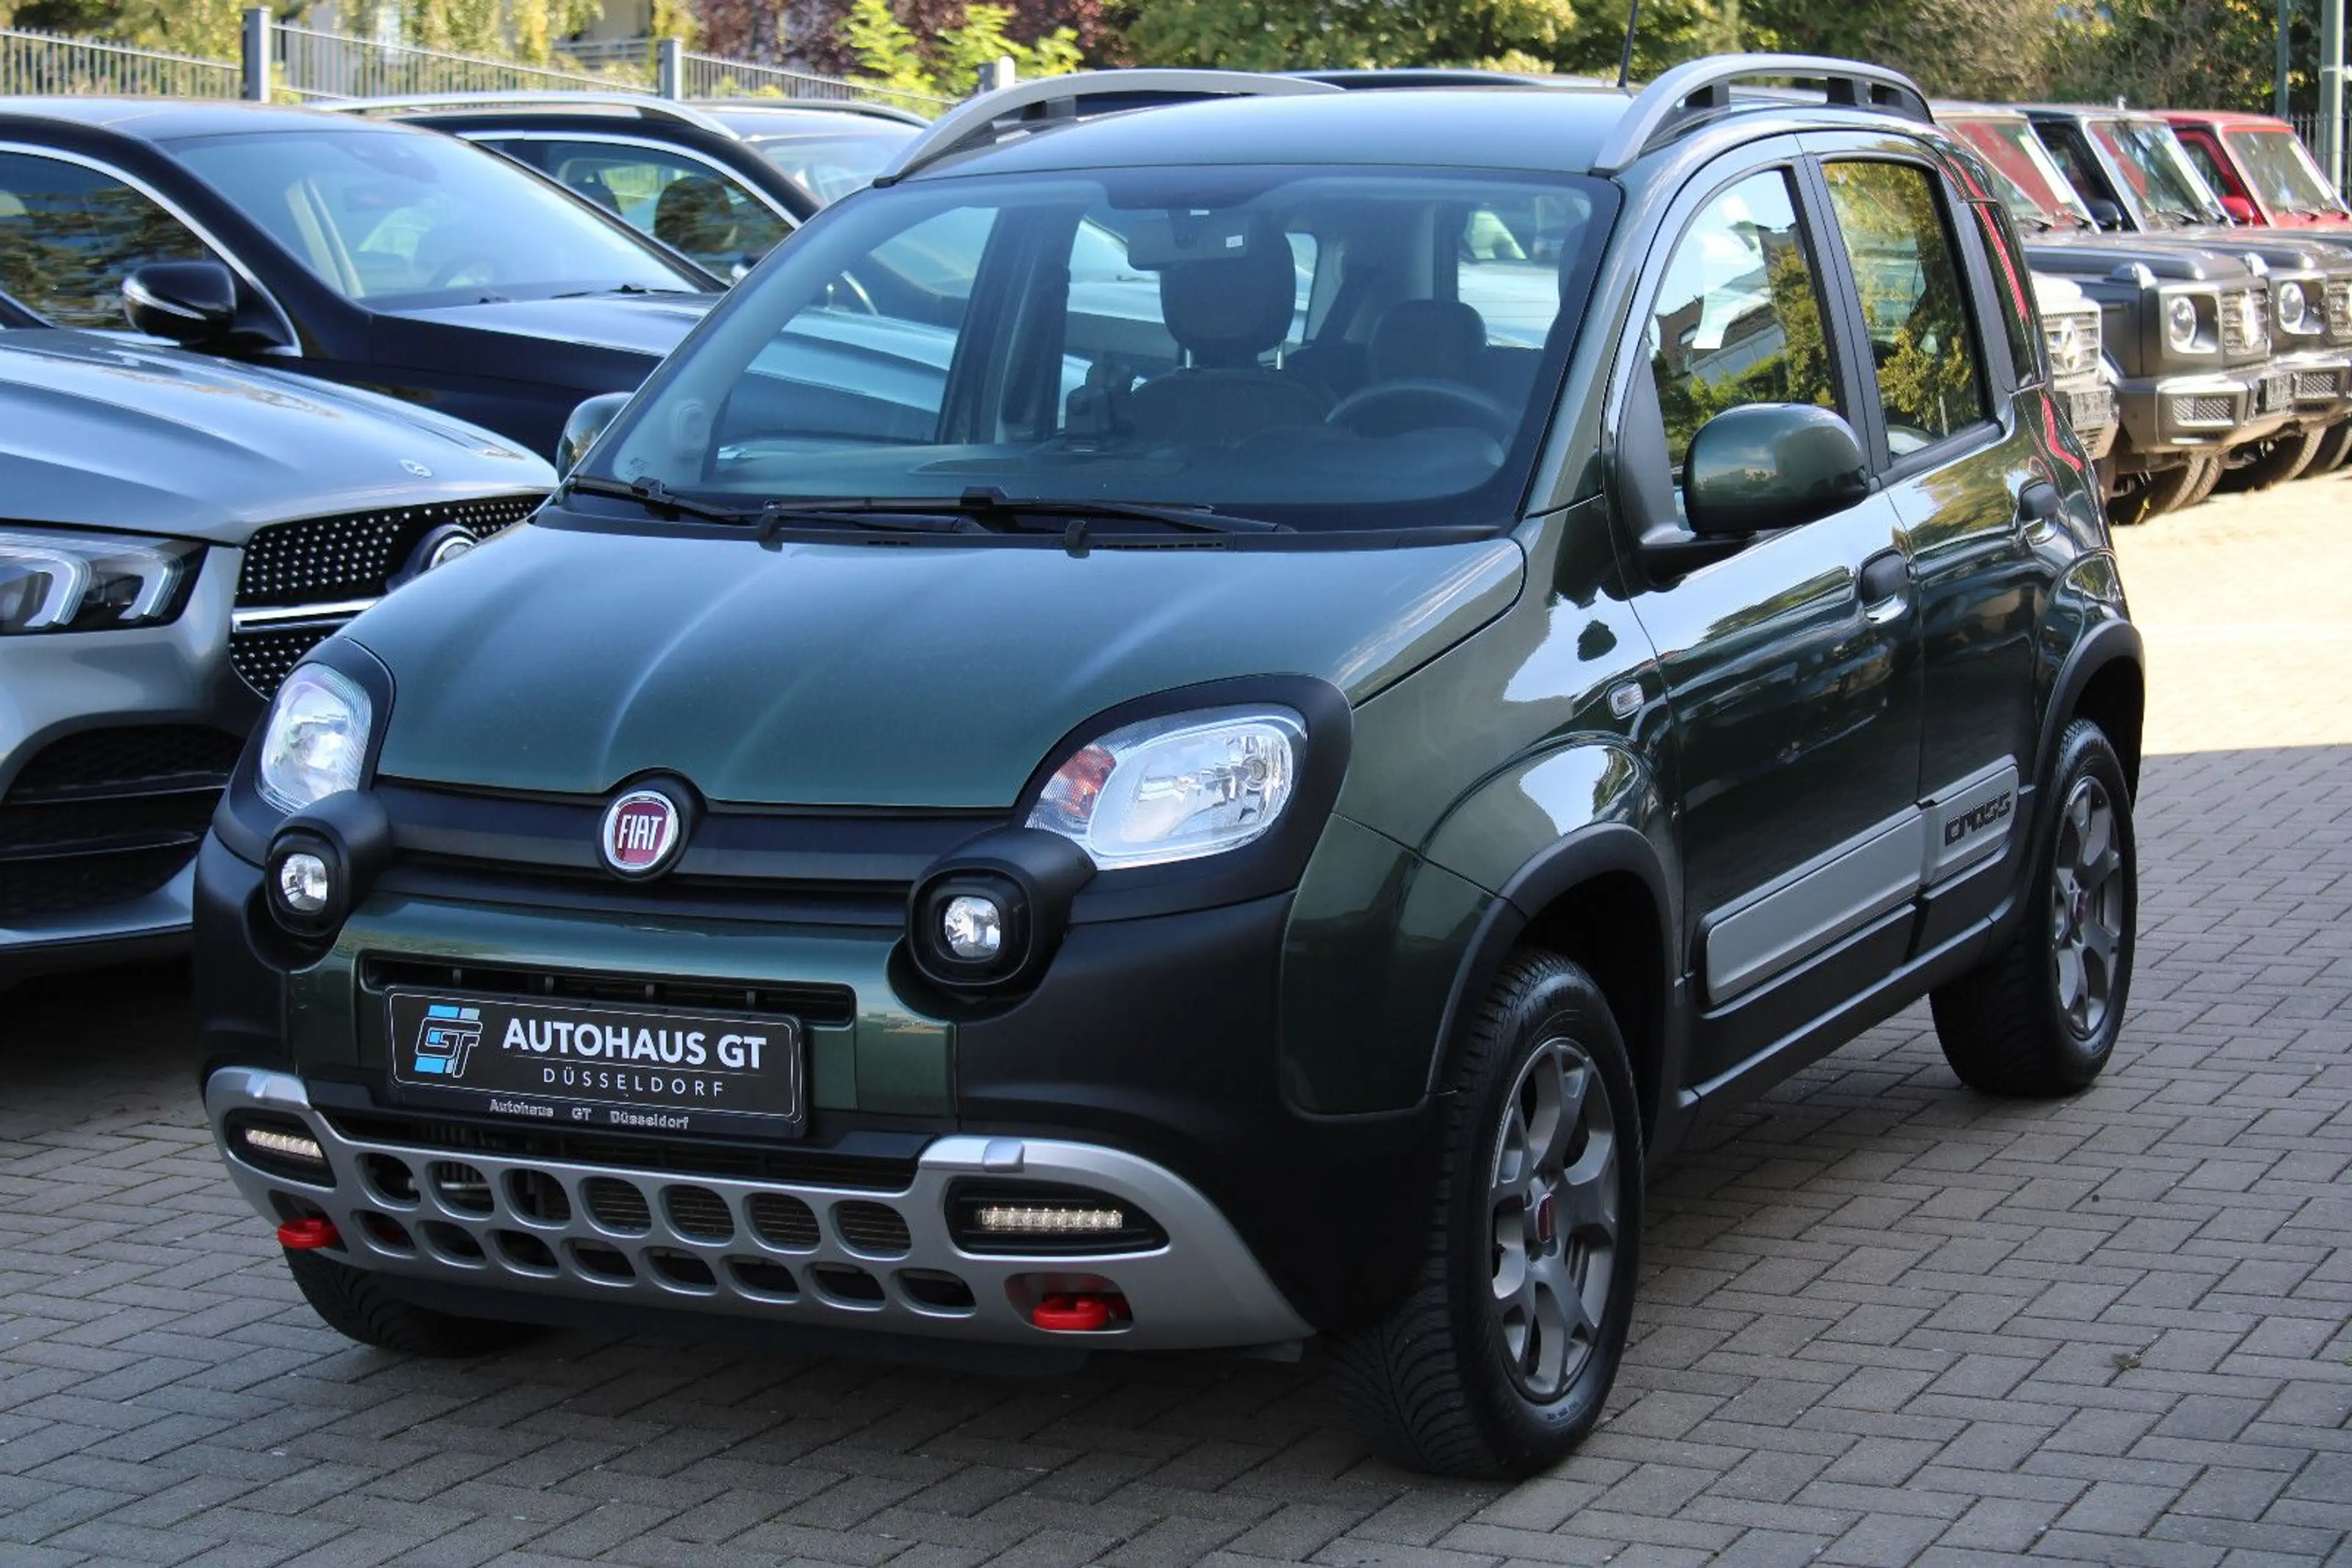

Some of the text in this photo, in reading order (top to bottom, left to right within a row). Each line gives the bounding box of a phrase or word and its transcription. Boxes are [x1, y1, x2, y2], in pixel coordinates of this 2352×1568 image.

[617, 813, 663, 850] FIAT
[1945, 790, 2011, 847] CROSS
[415, 1017, 483, 1077] GT
[503, 1018, 767, 1069] AUTOHAUS GT
[543, 1066, 723, 1097] DÜSSELDORF
[490, 1099, 690, 1129] Autohaus GT Düsseldorf
